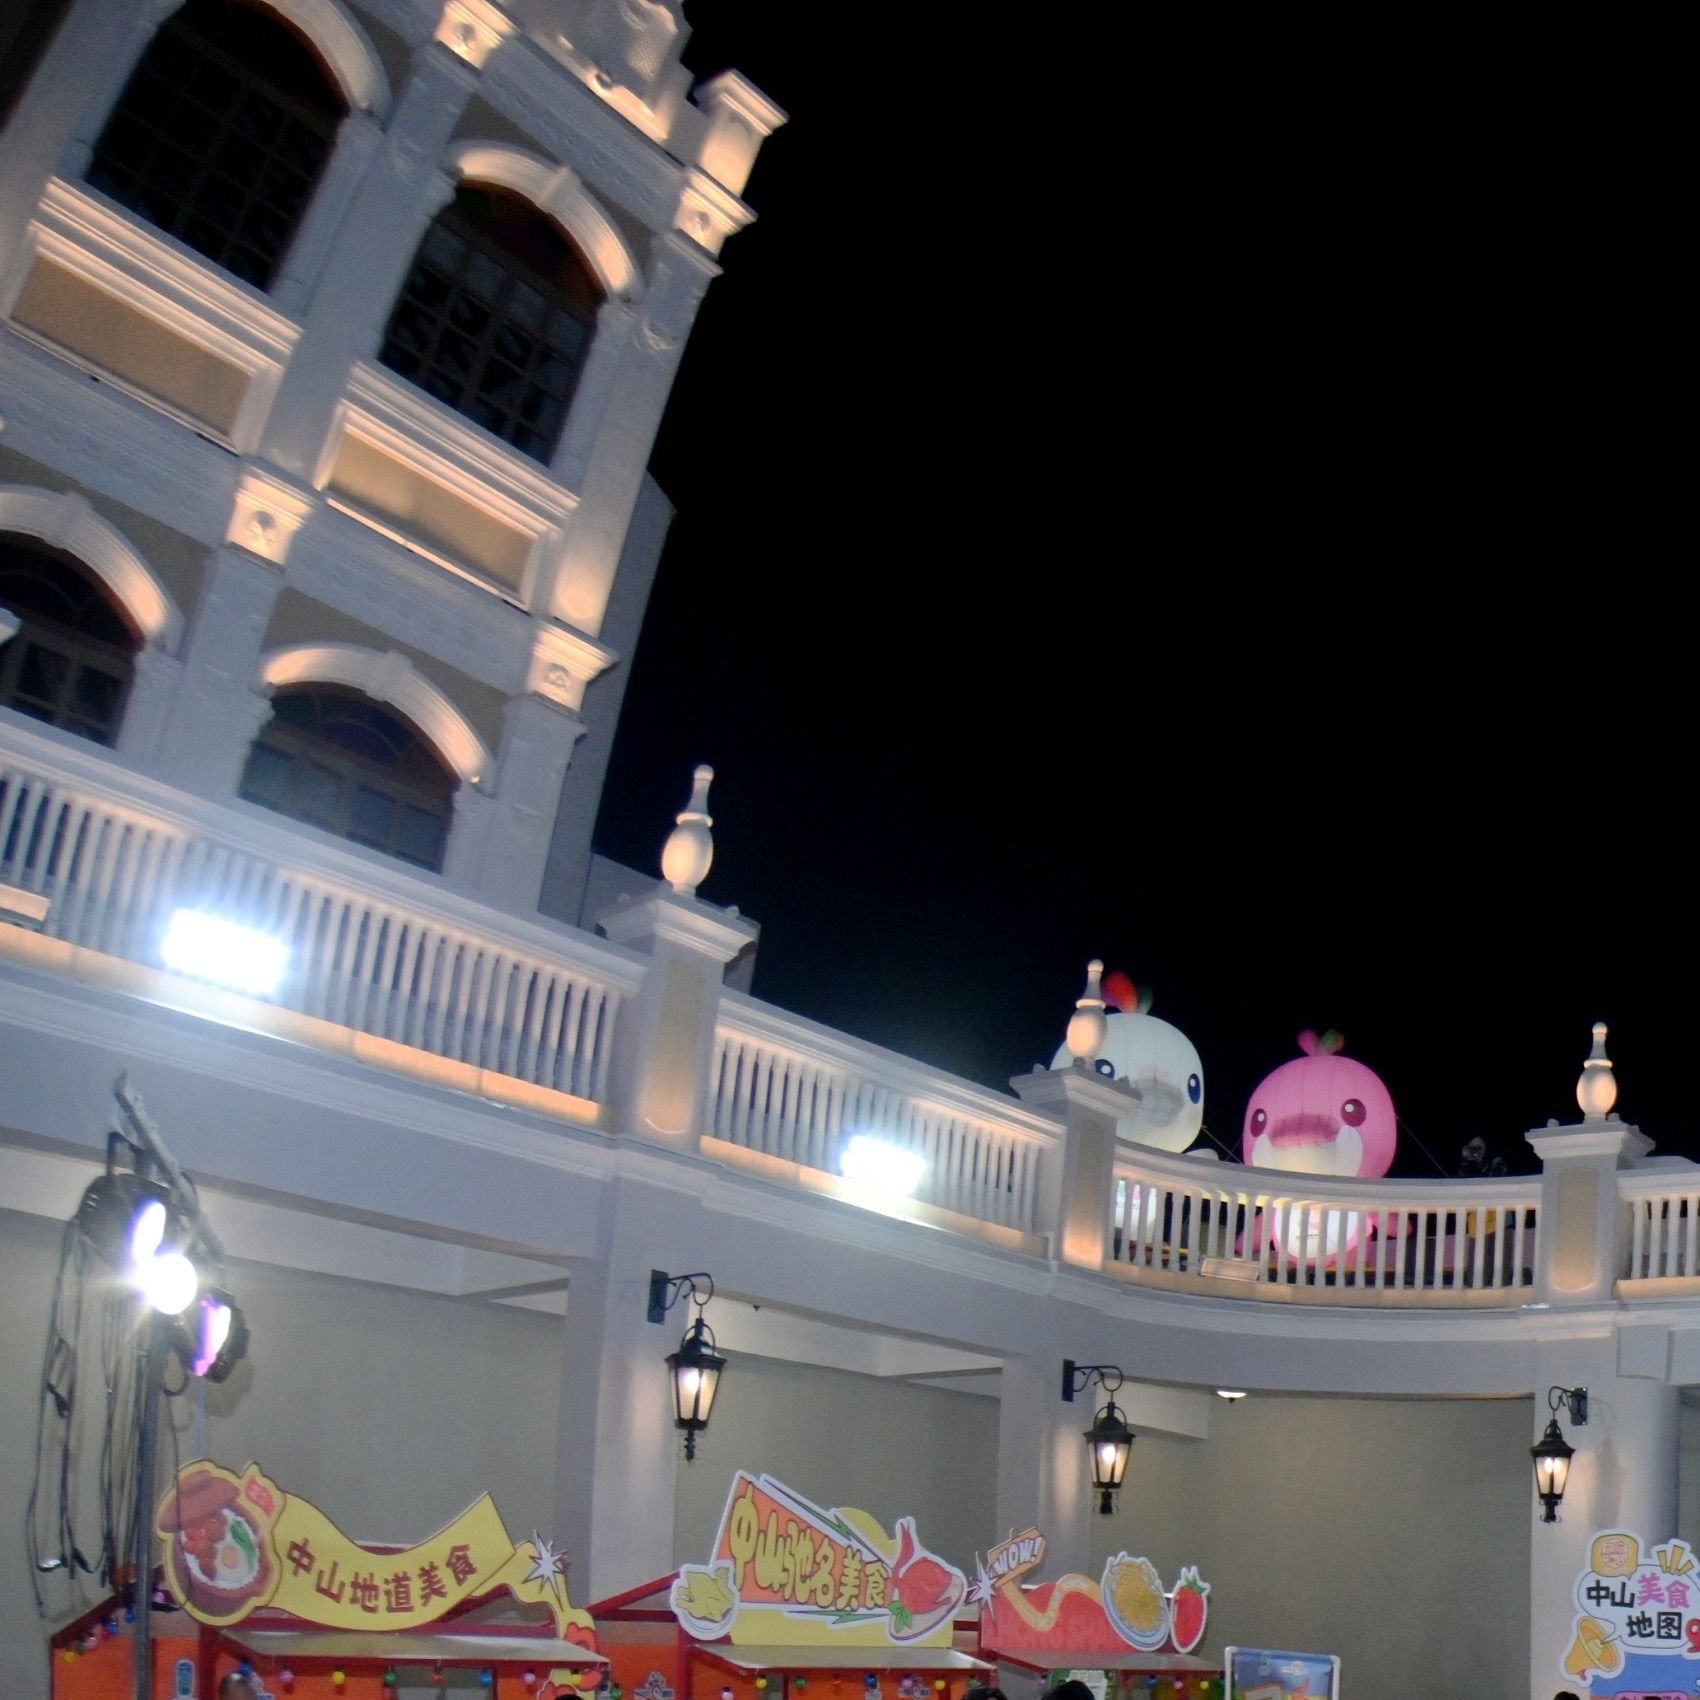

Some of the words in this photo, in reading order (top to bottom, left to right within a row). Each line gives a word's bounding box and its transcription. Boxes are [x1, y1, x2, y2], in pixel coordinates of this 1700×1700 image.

[990, 1537, 1042, 1575] WOW!
[285, 1537, 478, 1614] 中山地道美食
[1586, 1572, 1690, 1609] 中山美食
[1626, 1611, 1683, 1640] 地图
